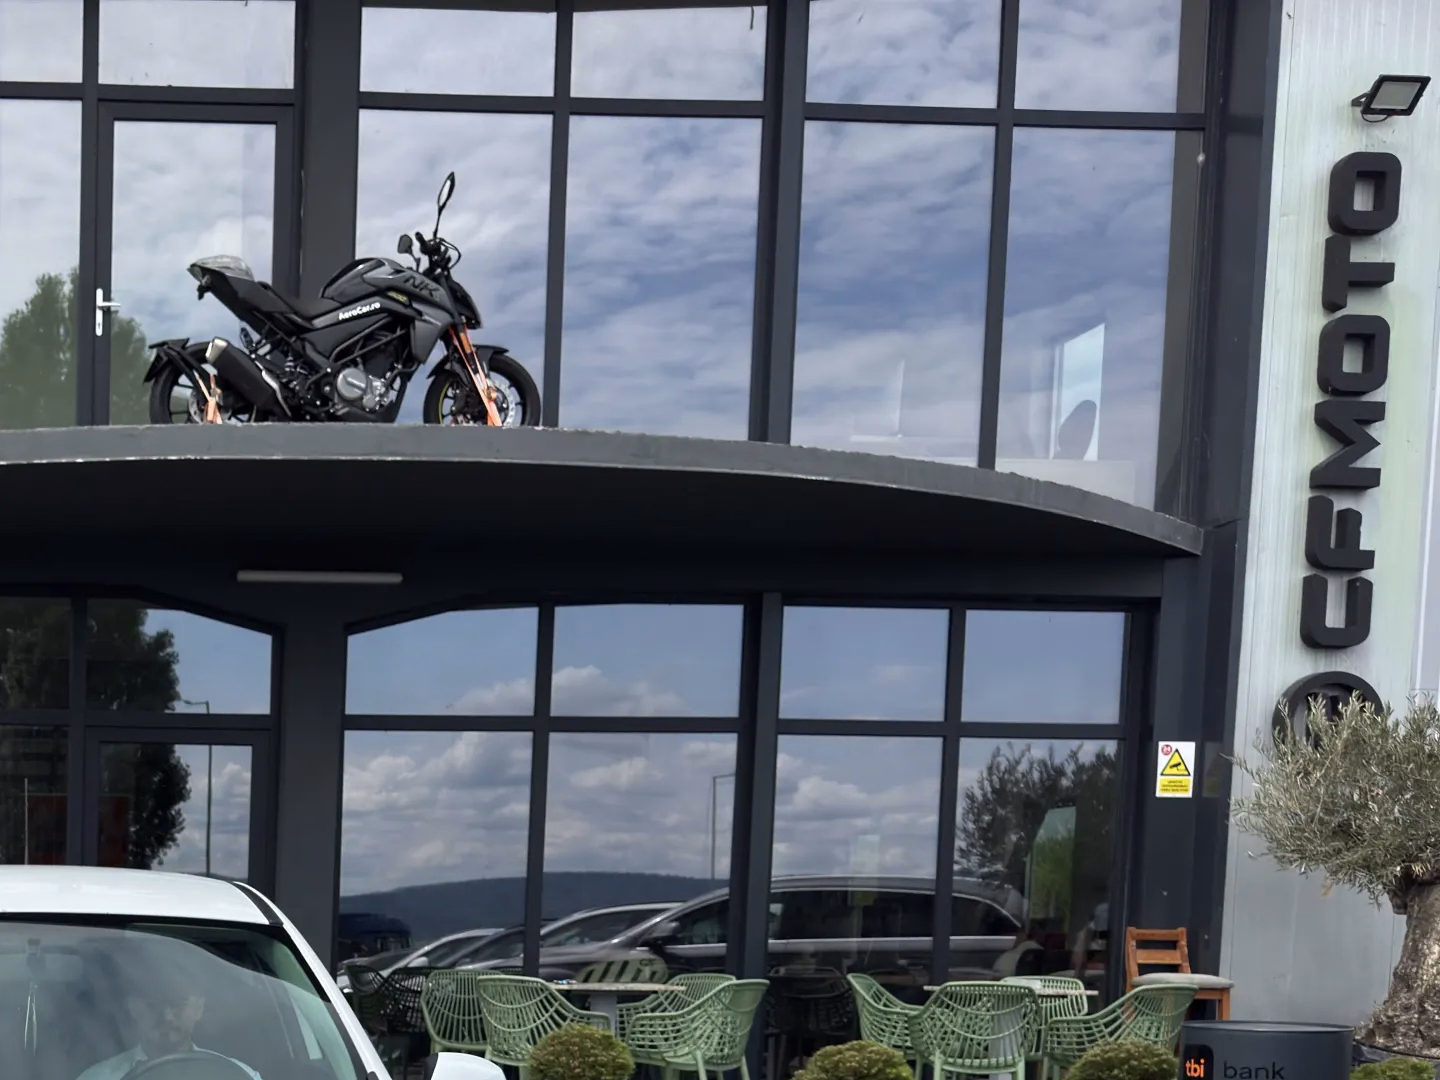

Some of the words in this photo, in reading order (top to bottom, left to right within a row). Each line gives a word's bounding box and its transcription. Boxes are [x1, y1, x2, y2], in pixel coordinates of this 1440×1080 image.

[339, 302, 381, 320] AeroCar.ro
[1299, 151, 1402, 649] CFMOTO
[1186, 1059, 1205, 1078] tbi
[1224, 1060, 1285, 1080] bank
